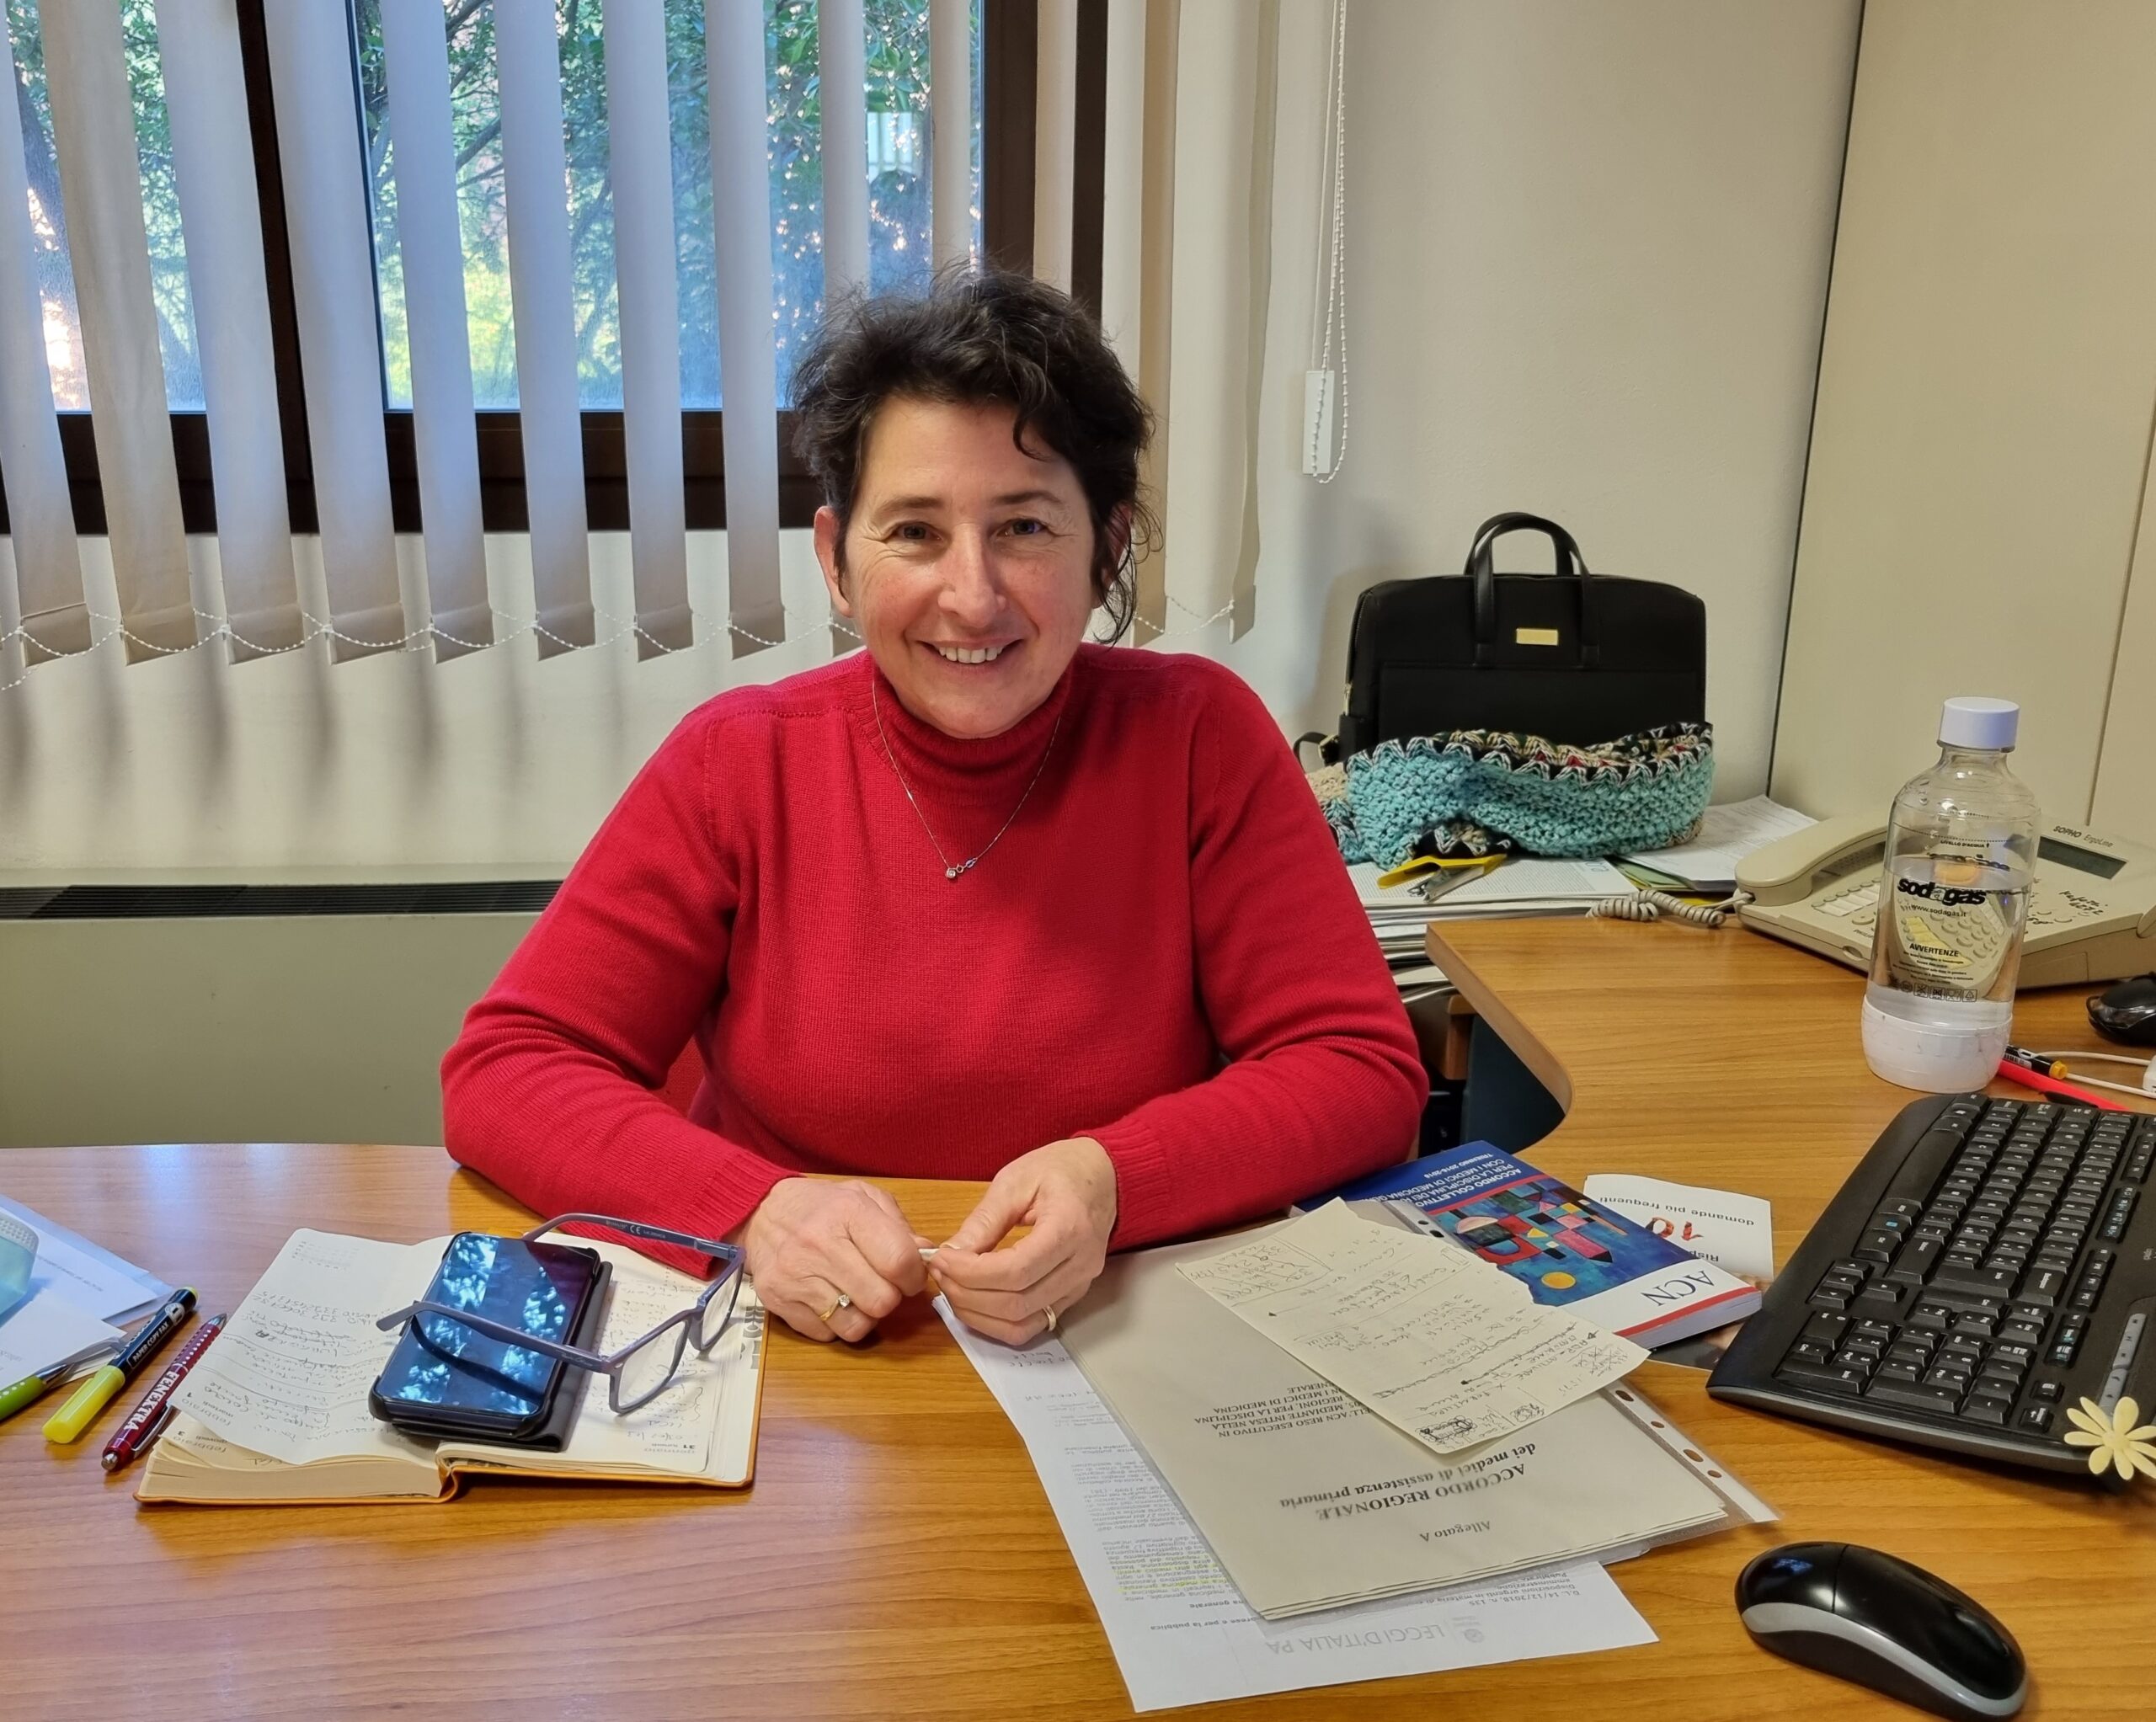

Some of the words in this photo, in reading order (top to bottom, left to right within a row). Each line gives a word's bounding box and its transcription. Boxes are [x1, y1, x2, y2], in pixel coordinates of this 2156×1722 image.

[2052, 825, 2082, 838] SOPHO
[1897, 878, 1987, 906] sodagas
[1911, 904, 1967, 917] www.sodagas.it
[1909, 942, 1960, 957] AVVERTENZE
[1486, 1159, 1505, 1171] CON
[1492, 1164, 1514, 1175] PER
[1434, 1178, 1444, 1186] DI
[1445, 1168, 1476, 1182] MEDICI
[1475, 1168, 1523, 1188] ACCORDO
[1479, 1170, 1491, 1180] LA
[1385, 1180, 1433, 1200] MEDICINA
[1428, 1174, 1479, 1197] DISCIPLINA
[1411, 1192, 1427, 1202] DEI
[1415, 1184, 1475, 1208] COLLETTIVO
[1599, 1197, 1660, 1210] frequenti
[1691, 1210, 1755, 1226] domande
[1645, 1218, 1705, 1242] 10
[1689, 1250, 1719, 1262] Risp
[1640, 1271, 1715, 1307] ACN
[132, 1344, 148, 1362] PAPER
[147, 1331, 160, 1346] COPY
[158, 1320, 169, 1334] FAX
[123, 1370, 180, 1431] FENEXTRA
[1283, 1391, 1323, 1403] MEDICI
[1213, 1401, 1267, 1415] MEDICINA
[1257, 1409, 1271, 1417] LA
[1272, 1404, 1294, 1415] PER
[1288, 1404, 1344, 1421] MEDIANTE
[1193, 1411, 1256, 1425] DISCIPLINA
[1248, 1415, 1286, 1426] INTESA
[1296, 1416, 1323, 1427] RESO
[1211, 1421, 1246, 1431] NELLA
[1232, 1421, 1293, 1437] ESECUTIVO
[173, 1436, 227, 1453] febbraio
[1512, 1442, 1536, 1460] dei
[1457, 1452, 1509, 1476] medici
[1434, 1463, 1526, 1498] ACCORDO
[1438, 1468, 1454, 1482] di
[1354, 1472, 1434, 1495] assistenza
[1278, 1486, 1351, 1510] primaria
[1315, 1489, 1430, 1522] REGIONALE
[1419, 1532, 1431, 1543] A
[1433, 1521, 1492, 1540] Allegato
[1188, 1601, 1230, 1610] generale
[1150, 1622, 1190, 1631] pubblica
[1383, 1624, 1446, 1643] LEGGI
[1264, 1639, 1295, 1655] PA
[1299, 1630, 1383, 1651] D'ITALIA
